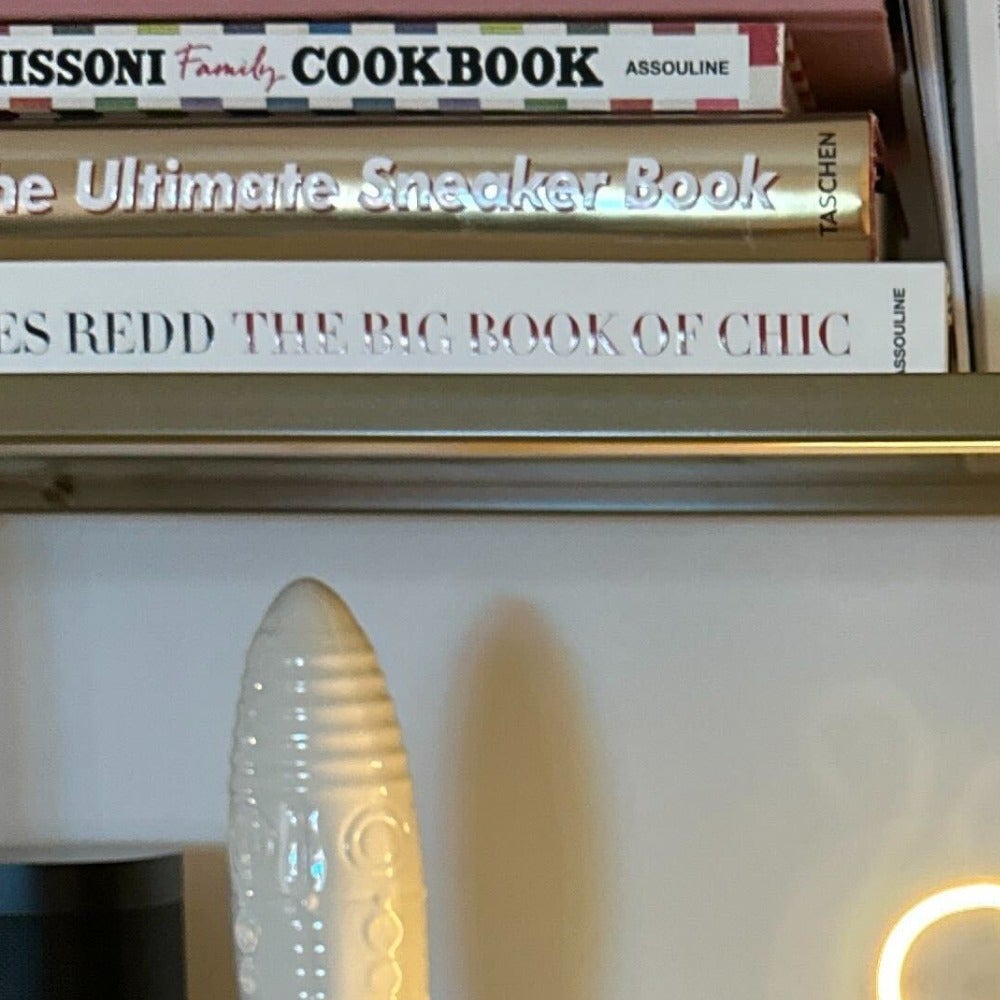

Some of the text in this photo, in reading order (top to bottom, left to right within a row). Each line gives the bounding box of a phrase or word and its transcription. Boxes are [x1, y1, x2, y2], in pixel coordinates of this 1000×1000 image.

[175, 42, 287, 92] Family
[292, 46, 604, 87] COOKBOOK
[625, 59, 731, 76] ASSOULINE
[75, 155, 340, 215] Ultimate
[357, 155, 612, 215] Sneaker
[624, 152, 782, 212] Book
[818, 131, 838, 238] TASCHEN
[66, 310, 216, 356] REDD
[232, 310, 349, 357] THE
[361, 310, 454, 357] BIG
[468, 311, 626, 358] BOOK
[631, 311, 704, 357] OF
[717, 311, 853, 358] CHIC
[893, 287, 907, 373] SSOULINE
